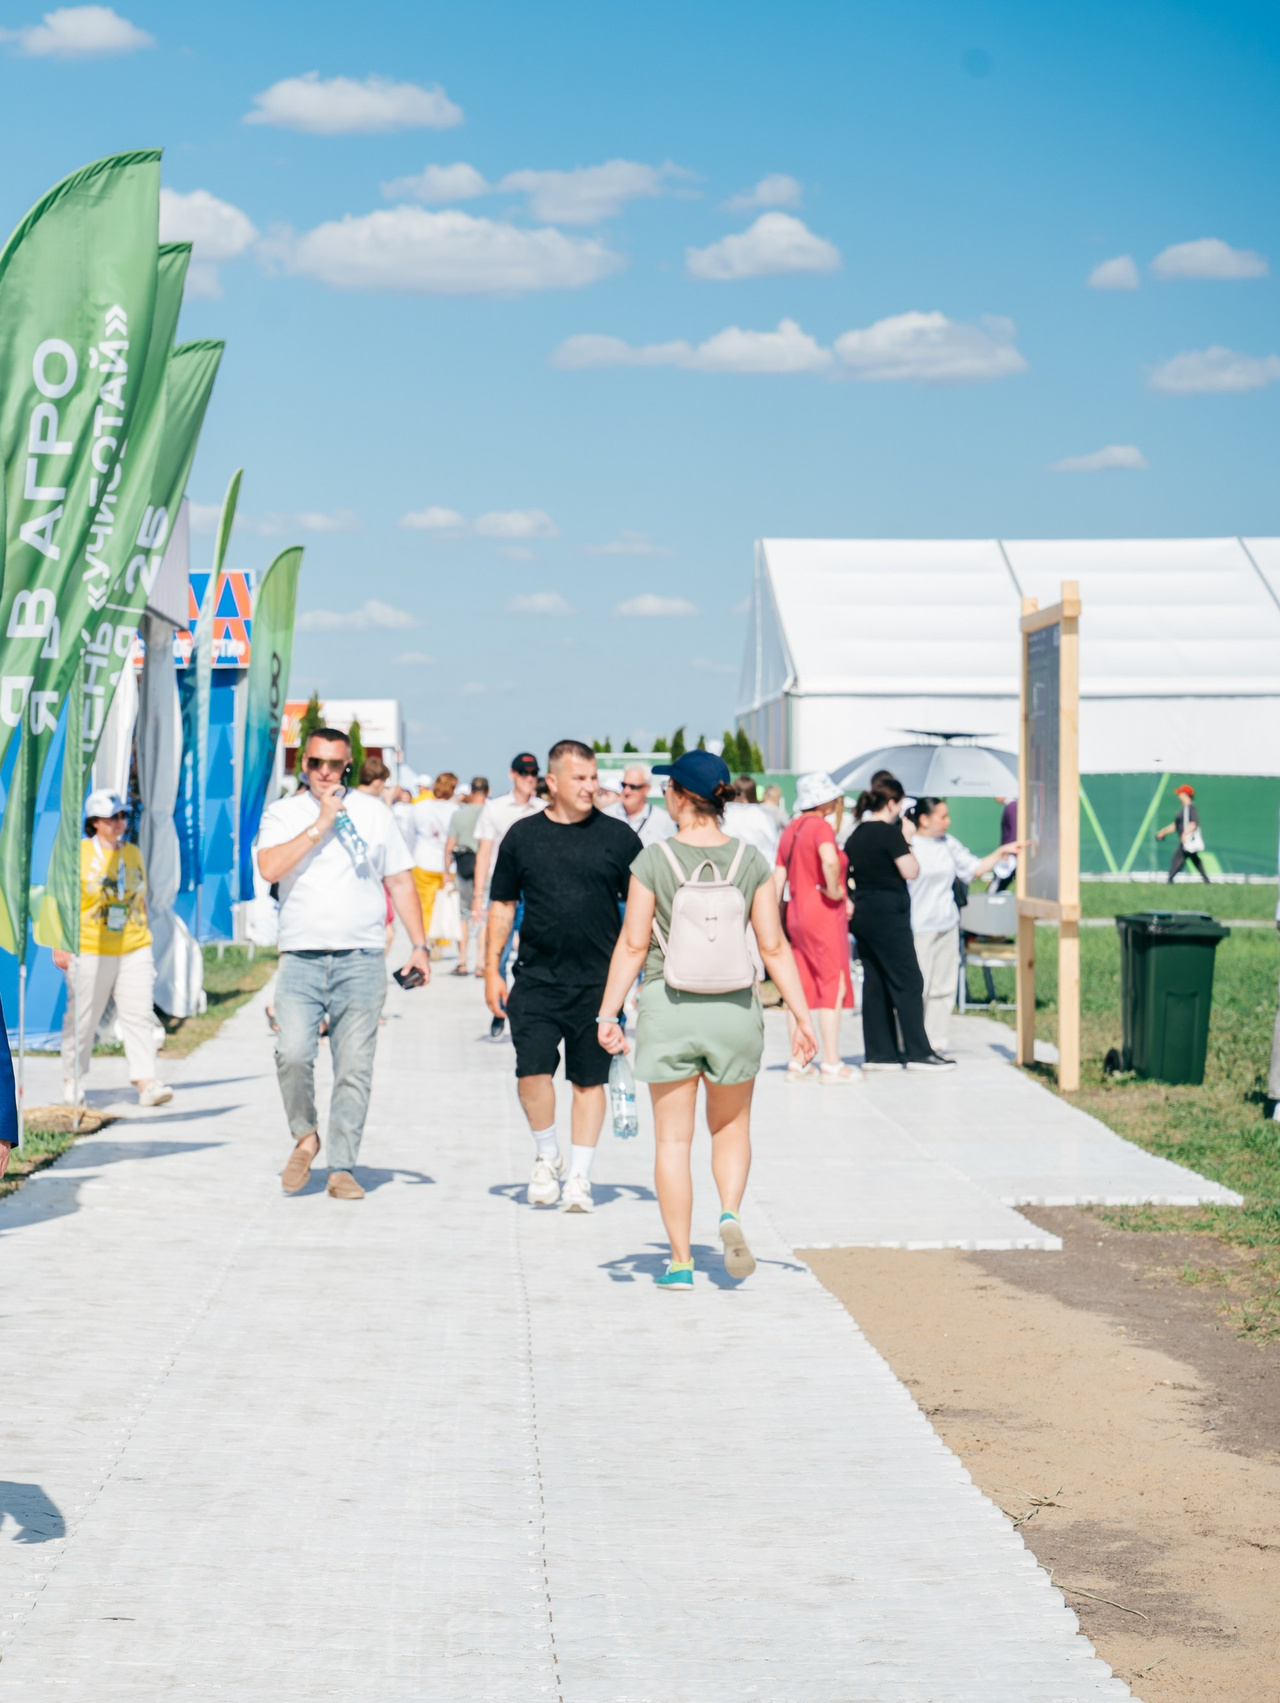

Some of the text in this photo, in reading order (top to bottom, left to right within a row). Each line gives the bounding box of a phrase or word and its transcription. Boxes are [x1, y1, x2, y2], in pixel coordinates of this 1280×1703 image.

[19, 338, 78, 561] АГРО
[124, 504, 169, 596] 25
[6, 587, 57, 638] В
